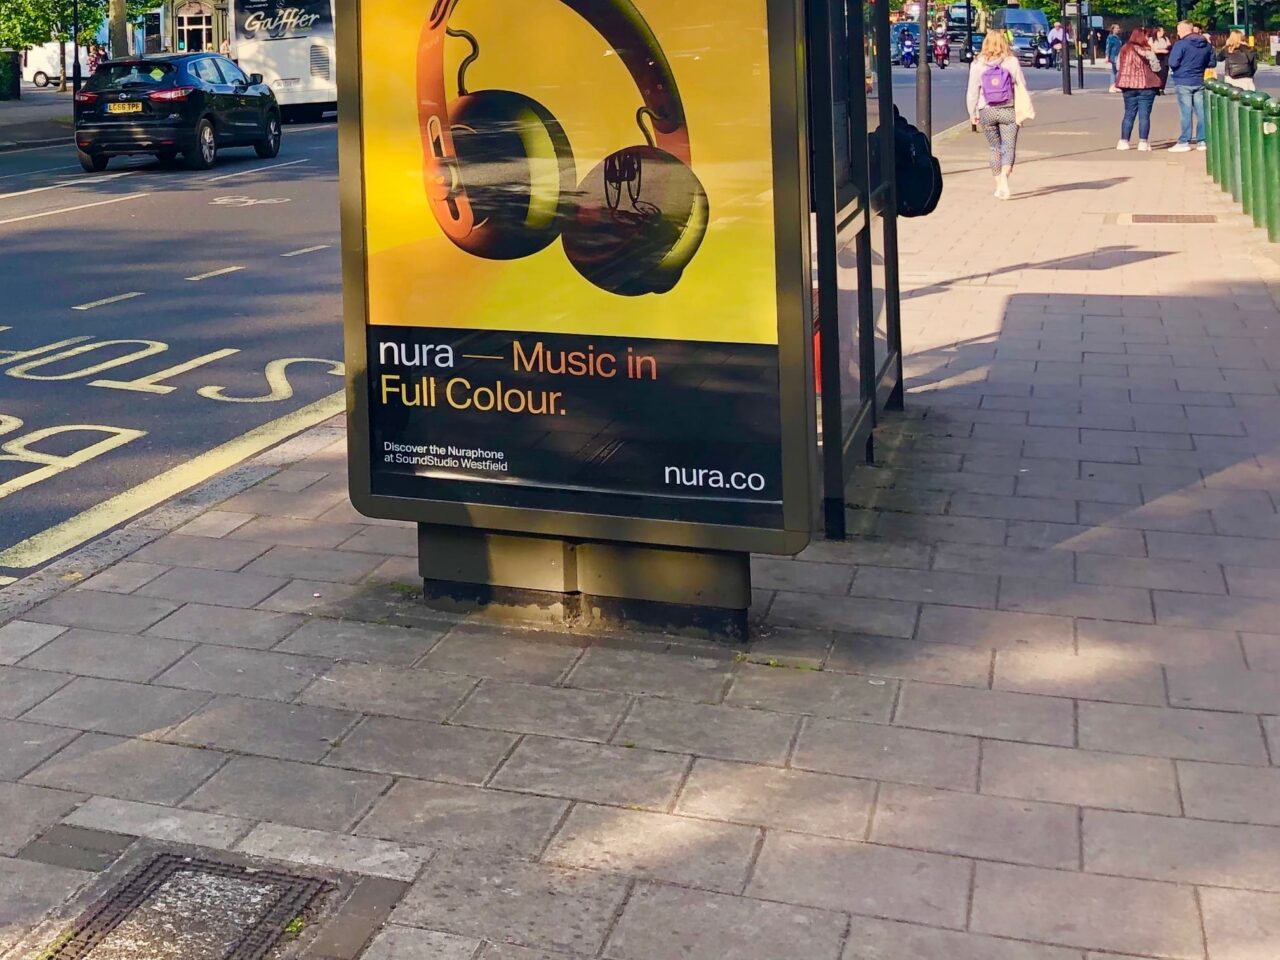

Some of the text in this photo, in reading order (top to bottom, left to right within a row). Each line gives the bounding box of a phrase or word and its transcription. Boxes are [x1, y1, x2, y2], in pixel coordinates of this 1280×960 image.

[379, 341, 454, 368] nura
[512, 340, 617, 378] Music
[627, 346, 657, 380] in
[381, 374, 567, 416] Full Colour.
[383, 441, 504, 460] Discover the Nuraphone
[384, 453, 508, 472] at SoundStudio Westfield
[664, 466, 766, 491] nura.co
